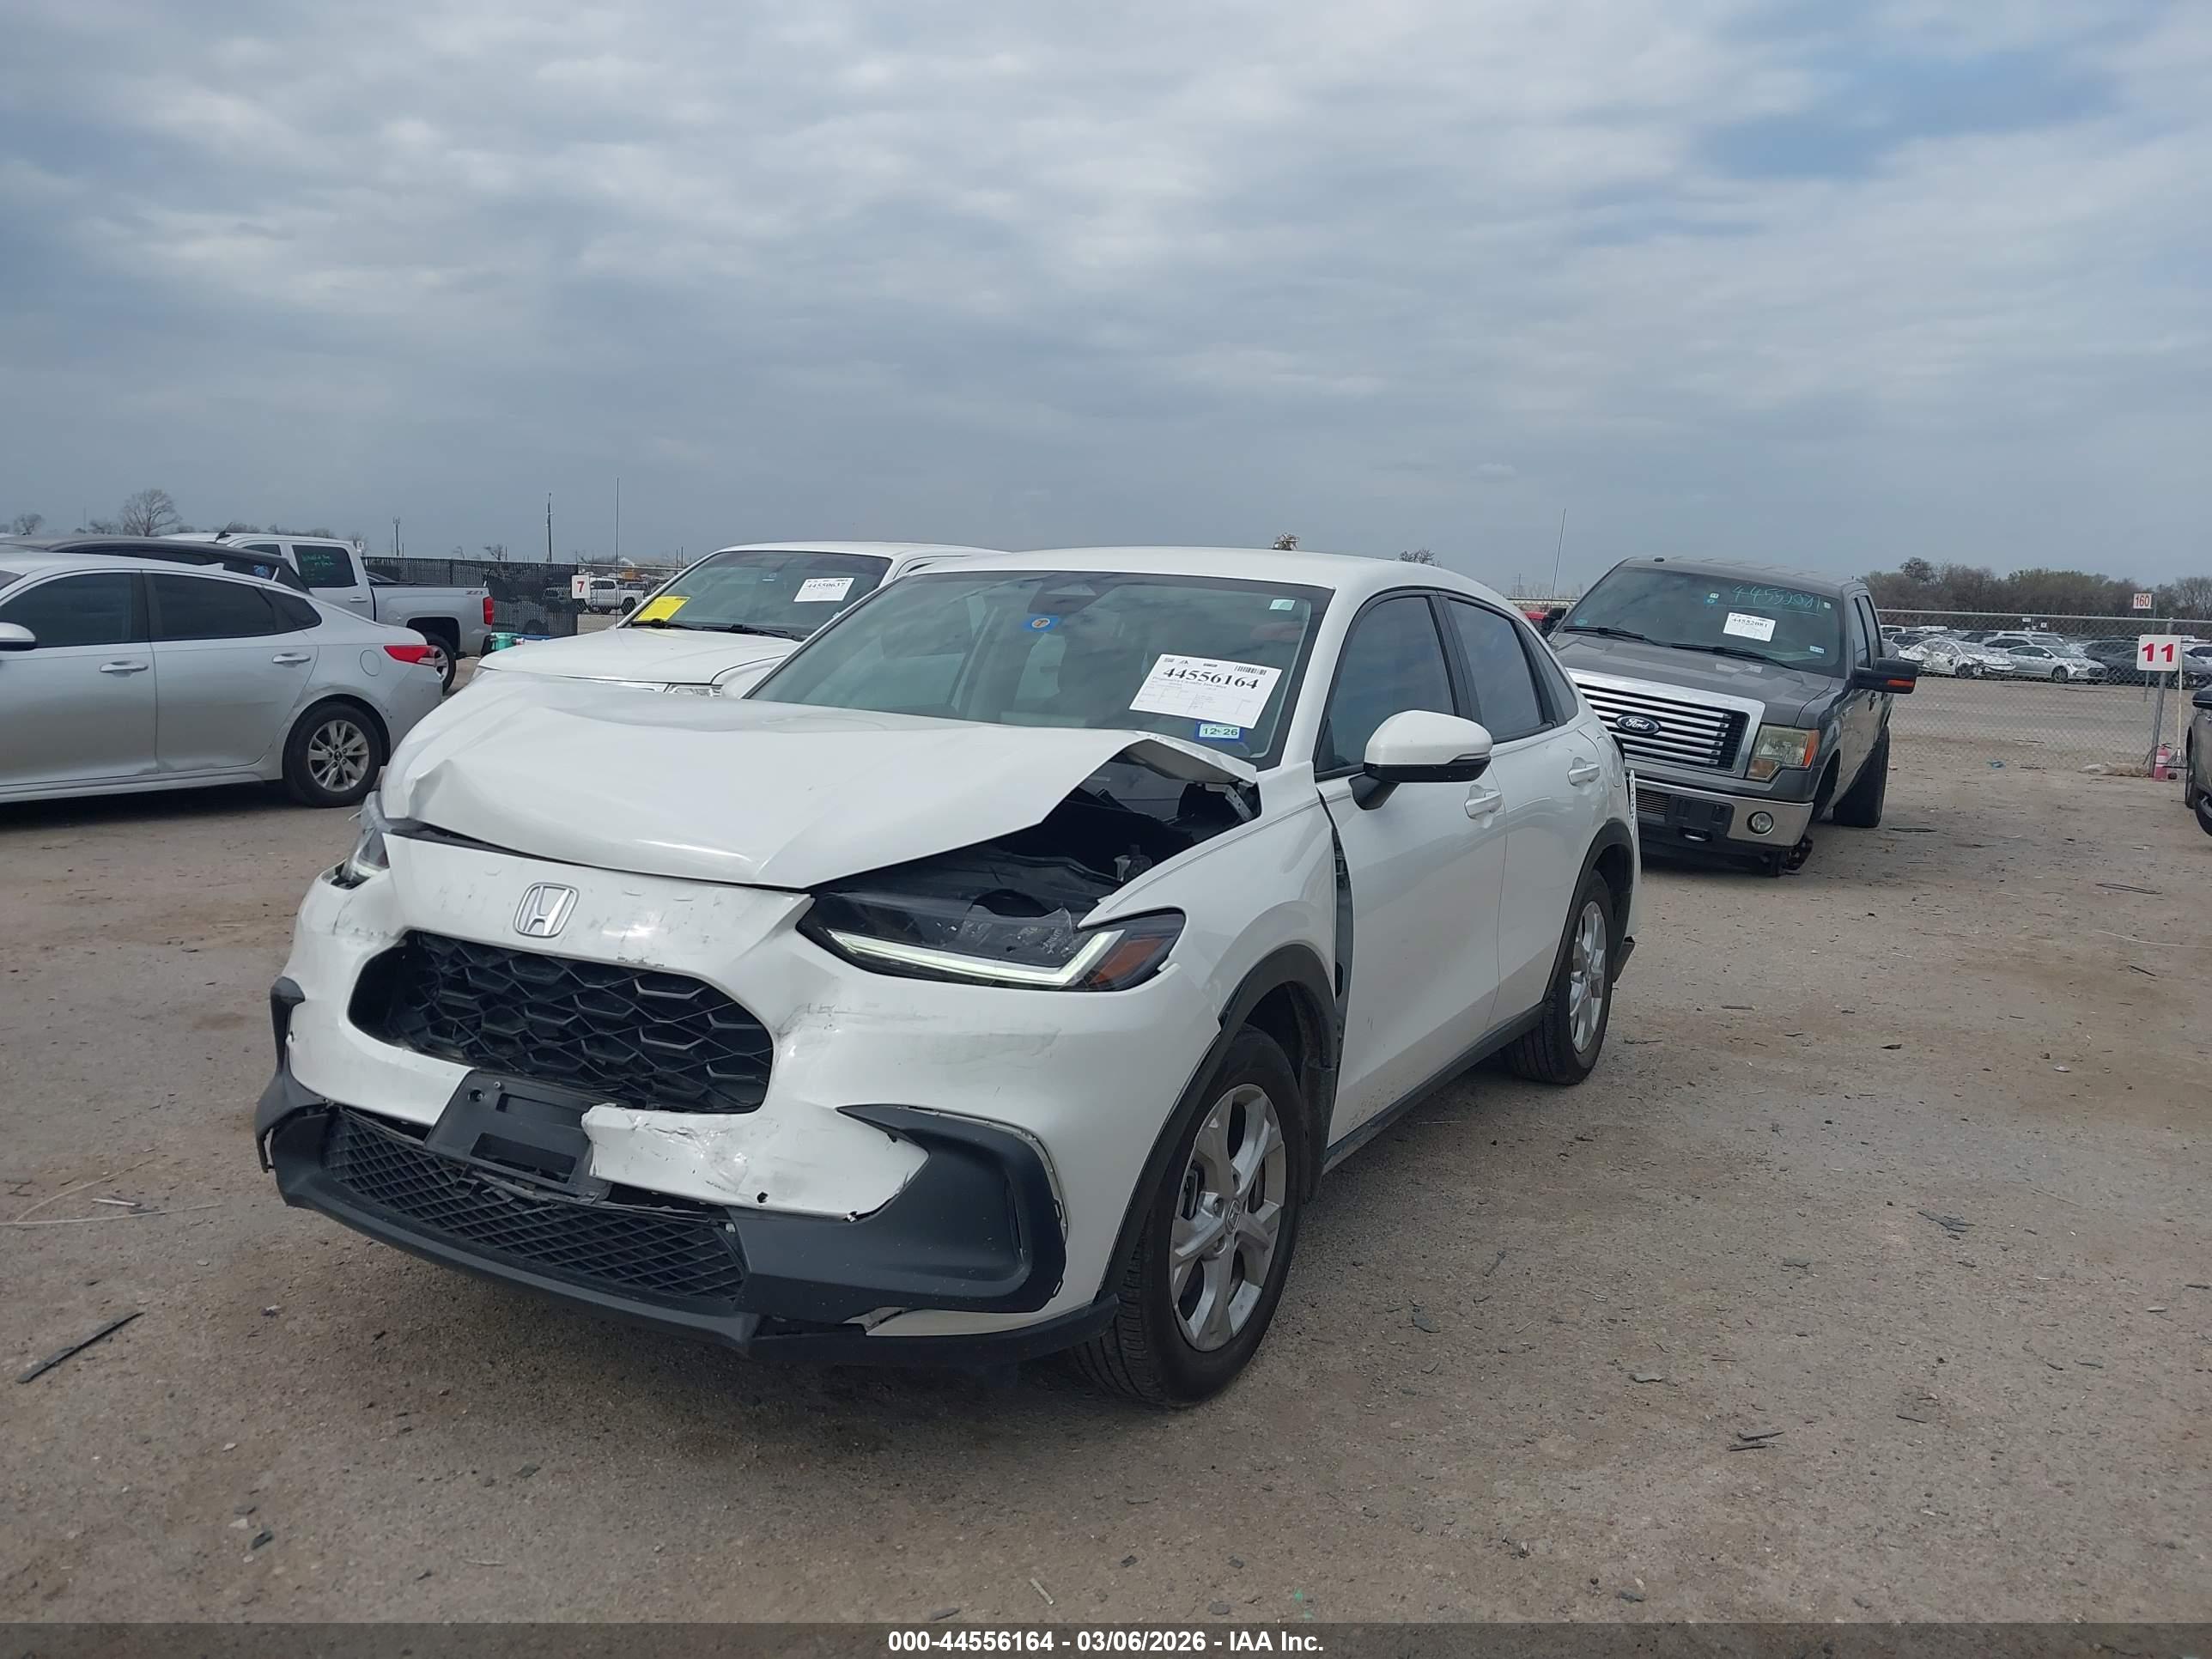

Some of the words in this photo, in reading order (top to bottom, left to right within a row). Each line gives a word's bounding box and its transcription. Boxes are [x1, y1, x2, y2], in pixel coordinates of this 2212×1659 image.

[576, 580, 585, 592] 7
[2136, 594, 2150, 607] 160
[2142, 642, 2174, 662] 11
[1163, 667, 1260, 690] 44556164
[1625, 718, 1650, 730] Ford
[1223, 727, 1238, 736] 26
